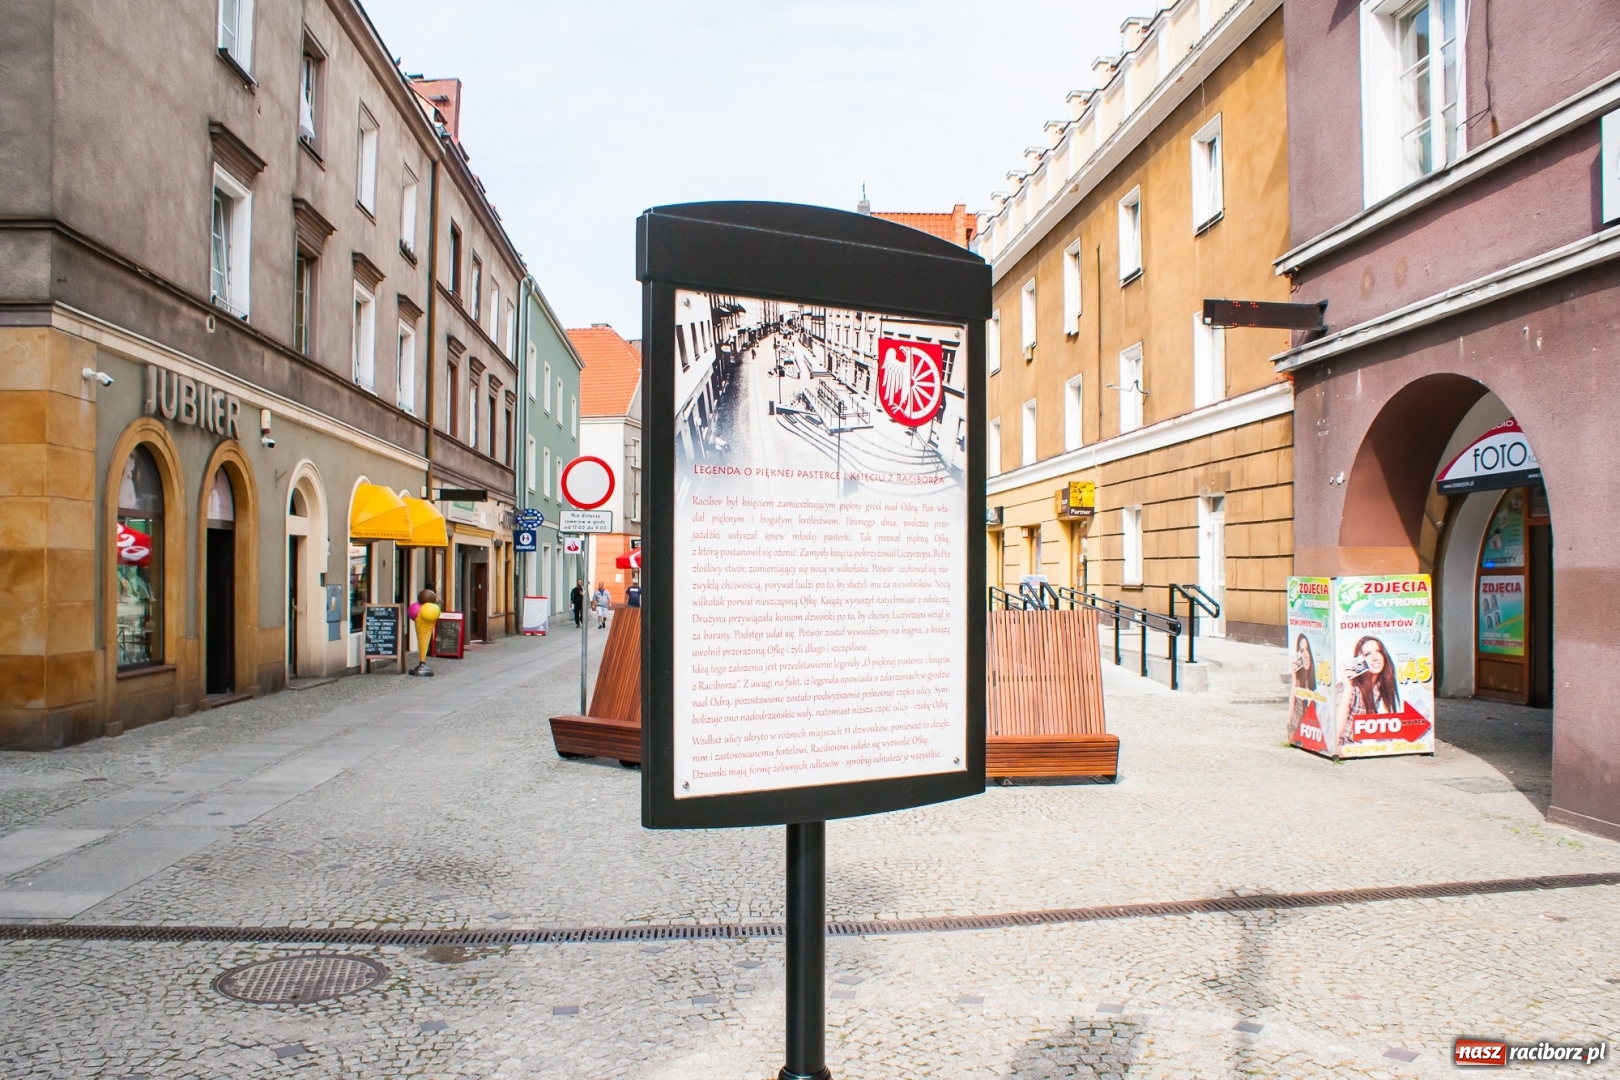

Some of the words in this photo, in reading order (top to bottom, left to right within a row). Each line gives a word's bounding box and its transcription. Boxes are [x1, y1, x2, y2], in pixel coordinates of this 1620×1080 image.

[145, 365, 240, 440] JUBILER
[1474, 442, 1527, 472] FOTO
[693, 465, 741, 476] LEGENDA
[797, 470, 840, 479] PASTERCE
[692, 496, 722, 506] Racibor
[742, 496, 774, 510] księciem
[839, 499, 862, 513] piękny
[865, 500, 881, 513] gród
[712, 513, 744, 527] pięknym
[760, 513, 792, 528] bogatym
[846, 516, 876, 529] Pewnego
[903, 516, 929, 529] podczas
[728, 530, 758, 543] usłyszał
[764, 531, 785, 544] śpiew
[792, 530, 817, 544] młodej
[878, 532, 901, 545] poznał
[906, 532, 928, 545] piękną
[698, 546, 719, 559] którą
[799, 547, 829, 560] Zamysły
[830, 547, 853, 559] księcia
[692, 562, 722, 576] złośliwy
[810, 566, 827, 575] nocą
[872, 562, 894, 572] Potwór
[692, 579, 719, 593] zwykłą
[764, 578, 794, 592] porywał
[795, 578, 814, 588] ludzi
[847, 578, 868, 591] służyli
[1364, 581, 1427, 595] ZDJĘCIA
[1482, 583, 1521, 595] ZDJĘCIA
[692, 595, 725, 606] wilkołak
[727, 595, 753, 609] porwał
[820, 595, 843, 607] Książę
[844, 594, 874, 607] wyruszył
[1375, 598, 1429, 607] CYFROWE
[692, 613, 726, 626] Drużyna
[775, 611, 803, 621] koniom
[804, 610, 835, 621] dzwonki
[868, 610, 890, 623] chciwy
[734, 628, 764, 641] Podstęp
[766, 627, 783, 638] udał
[798, 627, 823, 637] Potwór
[825, 626, 845, 636] został
[692, 645, 720, 656] uwolnił
[767, 644, 784, 657] Ofkę
[804, 643, 825, 656] długo
[692, 663, 709, 676] Ideą
[710, 663, 727, 676] tego
[728, 662, 763, 672] założenia
[834, 657, 860, 671] legendy
[872, 656, 896, 670] pięknej
[897, 655, 923, 668] pasterce
[750, 677, 772, 690] uwagi
[811, 674, 839, 688] legenda
[840, 672, 873, 687] opowiada
[927, 669, 950, 682] grodzie
[692, 696, 708, 707] nad
[786, 691, 812, 702] zostało
[862, 687, 894, 702] północnej
[896, 686, 914, 698] części
[692, 713, 723, 727] bolizuje
[815, 704, 850, 716] natomiast
[852, 704, 873, 714] niższa
[874, 703, 891, 715] część
[892, 702, 908, 714] ulicy
[914, 700, 931, 712] rzekę
[692, 733, 722, 744] Wzdłuż
[724, 732, 742, 745] ulicy
[744, 730, 769, 744] ukryto
[778, 727, 806, 741] różnych
[808, 724, 842, 739] miejscach
[891, 720, 921, 734] ponieważ
[1300, 723, 1322, 742] FOTO
[1354, 718, 1402, 735] FOTO
[692, 752, 708, 762] nim
[850, 740, 870, 750] udało
[881, 737, 910, 752] wyzwolić
[1344, 744, 1387, 756] expres
[692, 766, 726, 778] Dzwonki
[728, 765, 747, 778] mają
[749, 764, 771, 777] formę
[773, 759, 808, 774] żeliwnych
[809, 758, 839, 769] odlewów
[846, 755, 872, 769] spróbuj
[872, 753, 902, 764] odnaleźć
